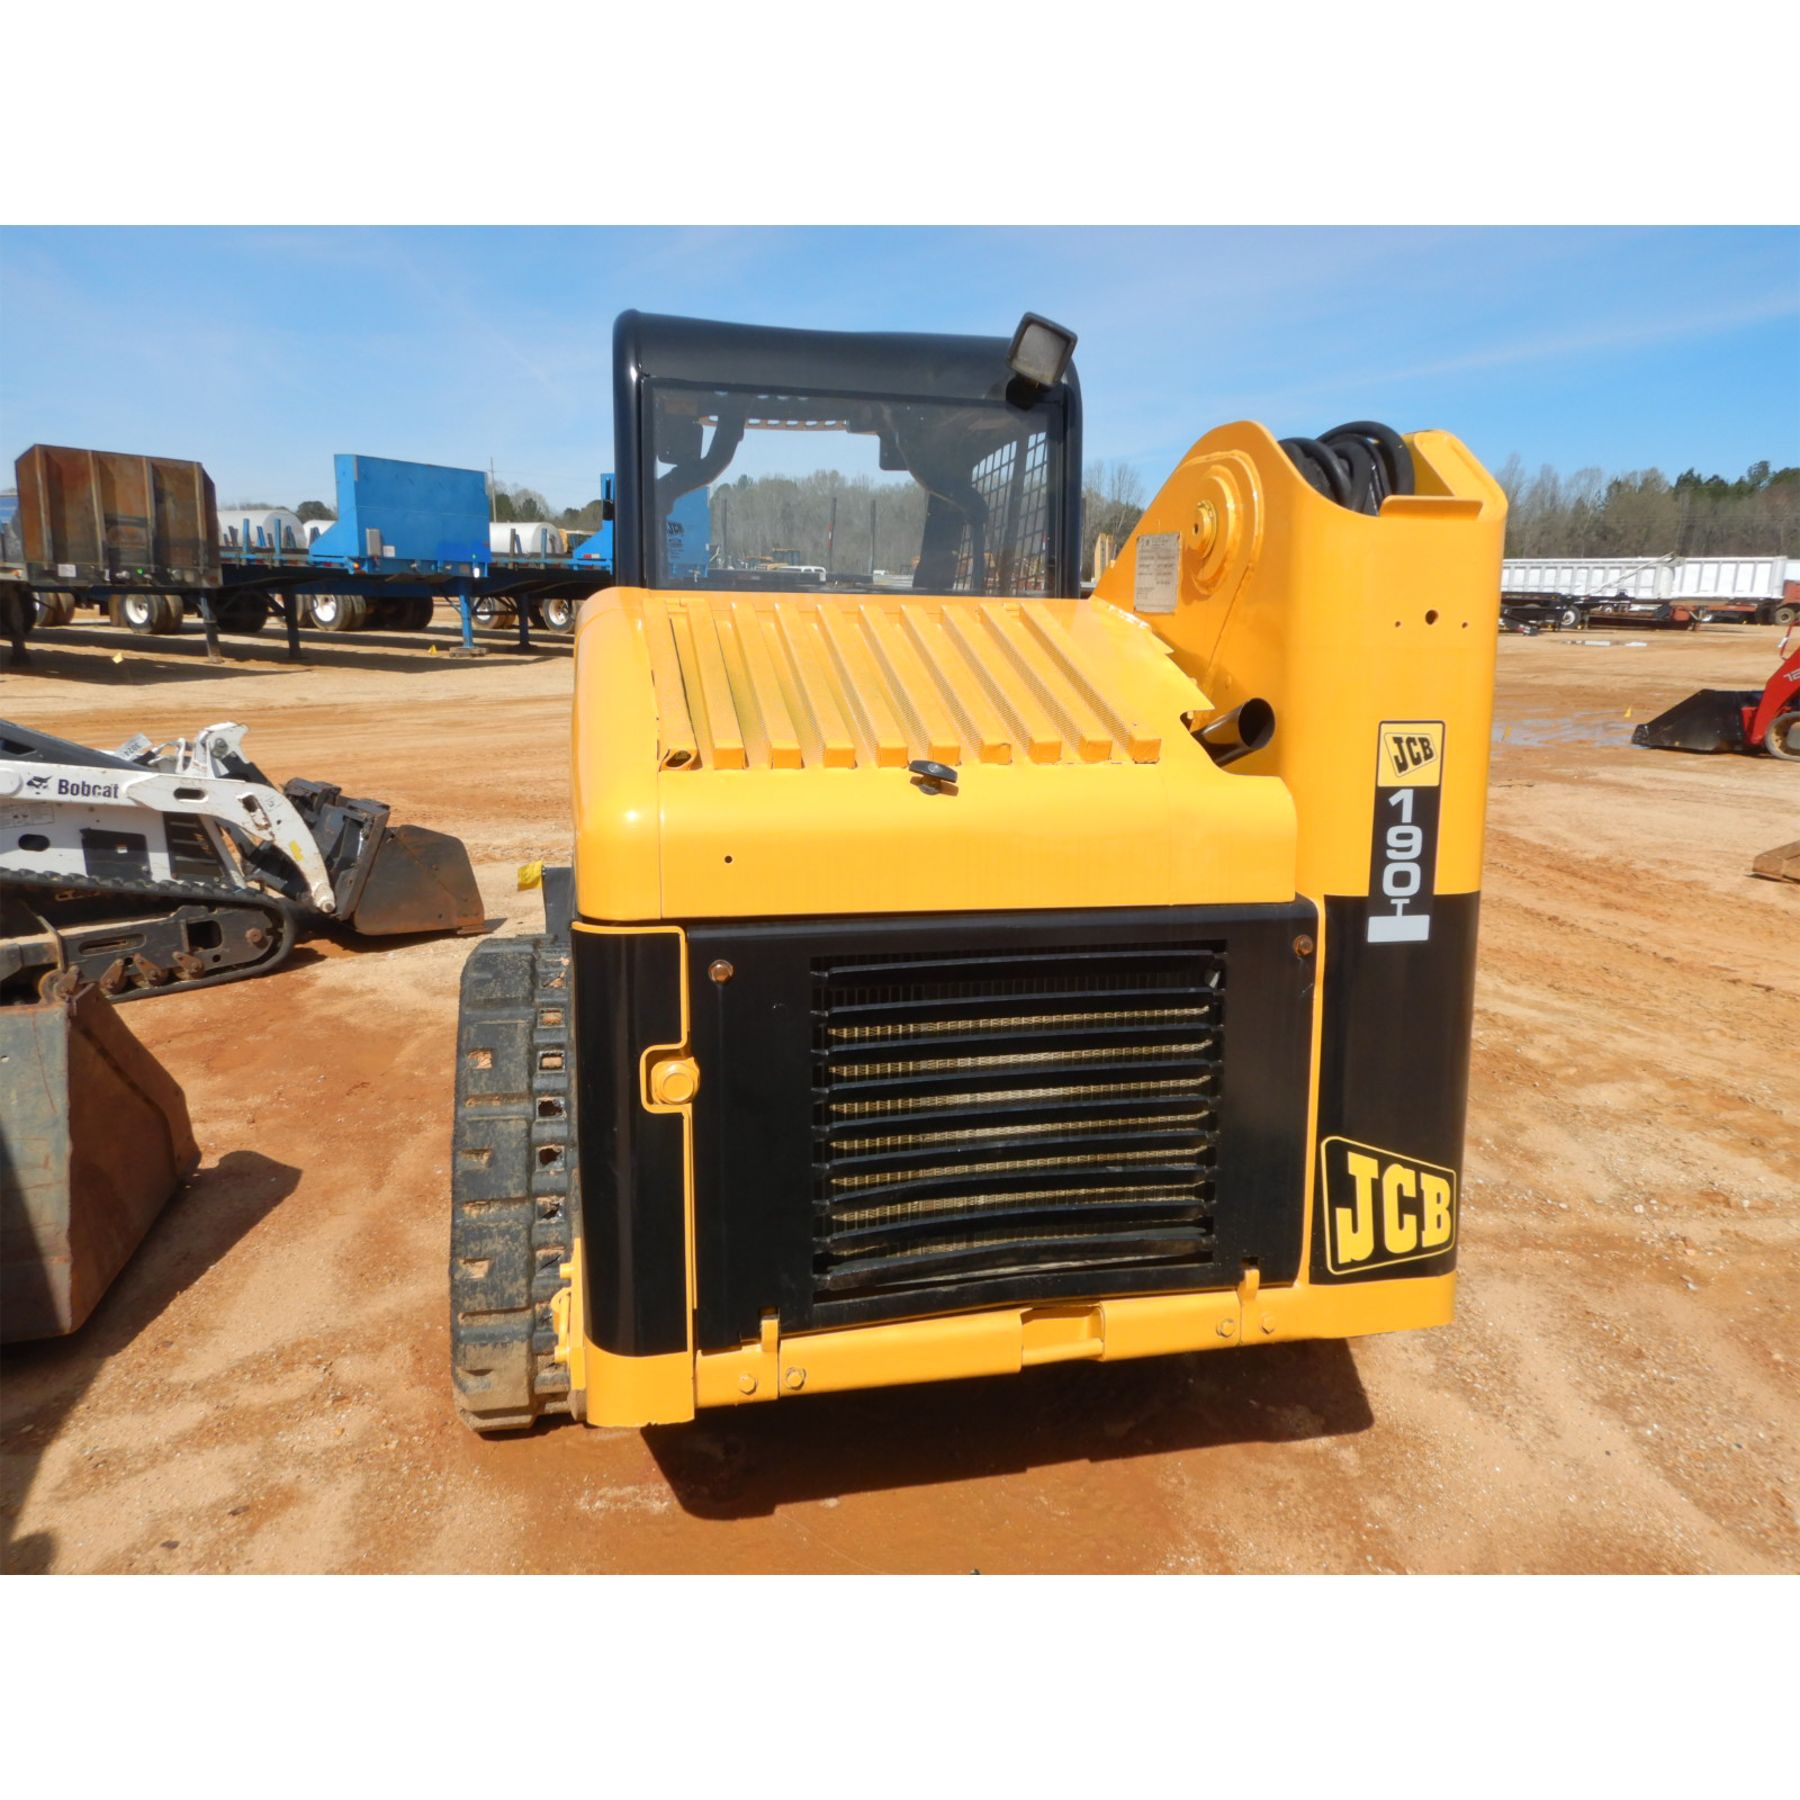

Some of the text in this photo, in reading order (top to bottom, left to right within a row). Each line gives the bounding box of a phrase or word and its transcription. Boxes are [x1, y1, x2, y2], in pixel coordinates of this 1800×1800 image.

[1393, 736, 1434, 774] JCB
[57, 779, 119, 799] Bobcat
[1335, 1151, 1451, 1264] JCB
